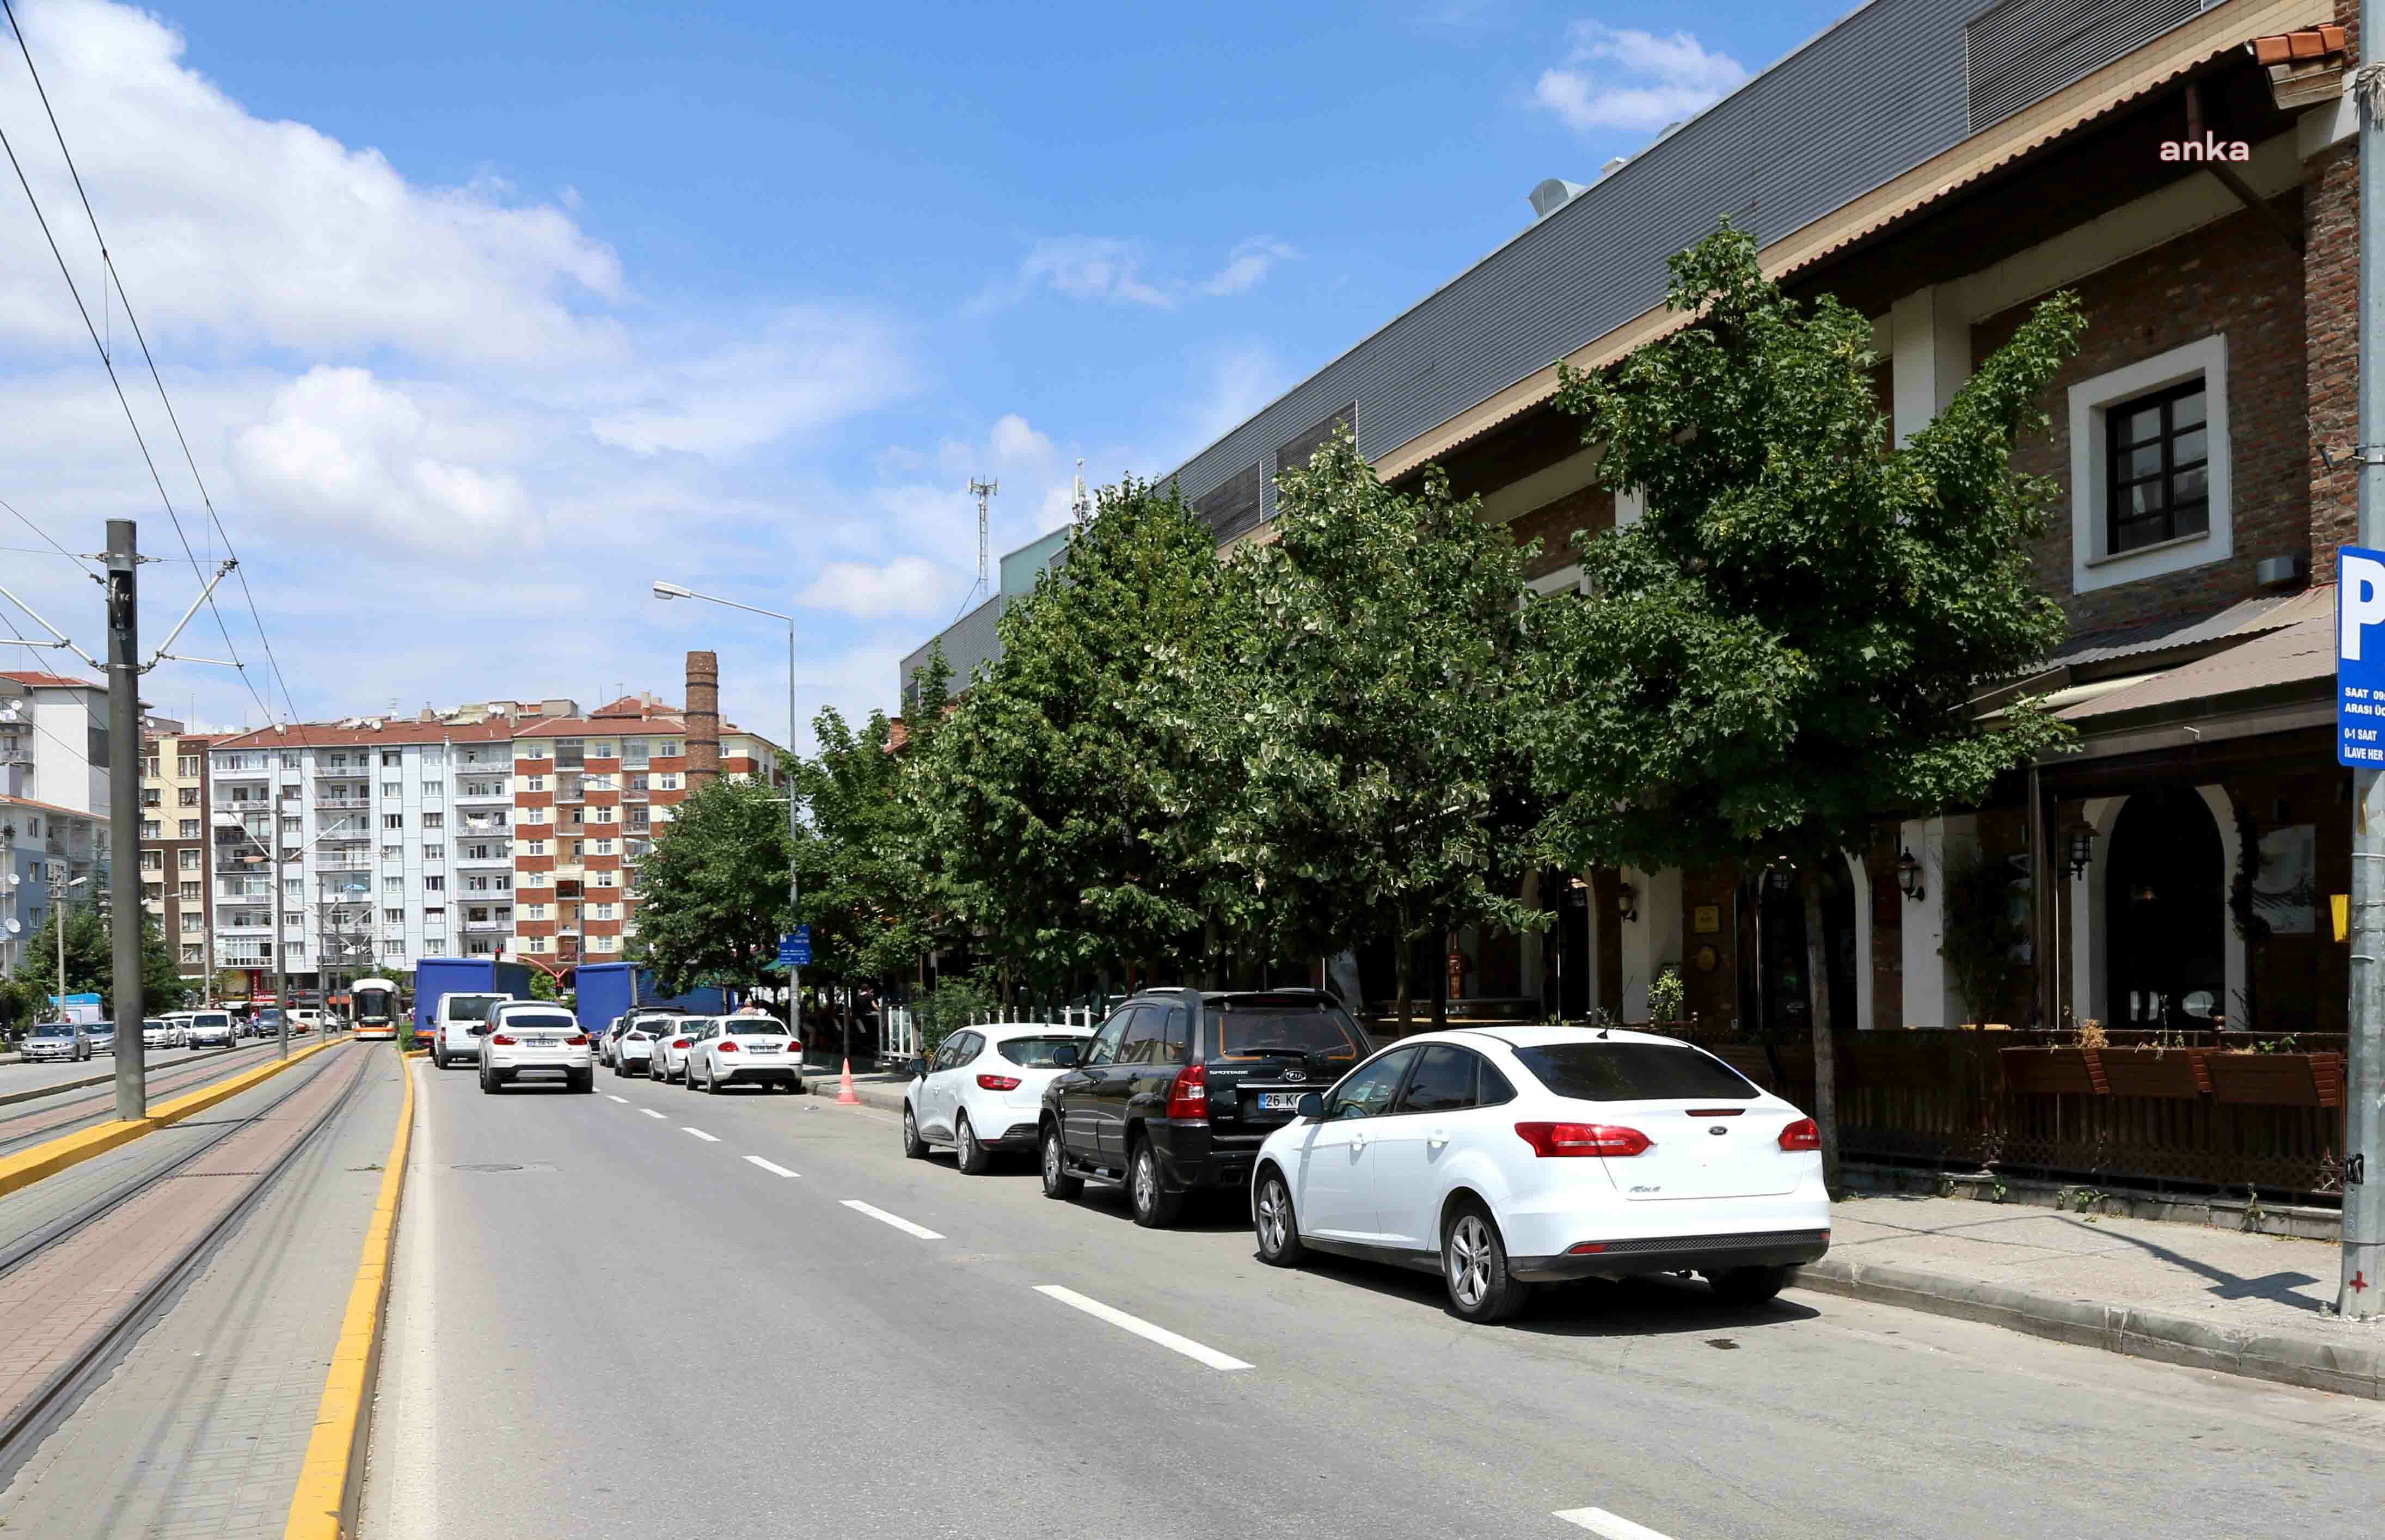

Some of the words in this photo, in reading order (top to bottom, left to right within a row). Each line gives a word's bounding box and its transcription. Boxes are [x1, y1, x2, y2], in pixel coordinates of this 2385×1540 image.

[2341, 555, 2385, 660] P
[2345, 687, 2369, 699] SAAT
[2345, 703, 2372, 715] ARASI
[2344, 727, 2356, 740] 0-1
[2358, 729, 2377, 741] SAAT
[2344, 744, 2366, 759] İLAVE
[2368, 748, 2383, 760] HER
[1266, 1095, 1280, 1106] 26
